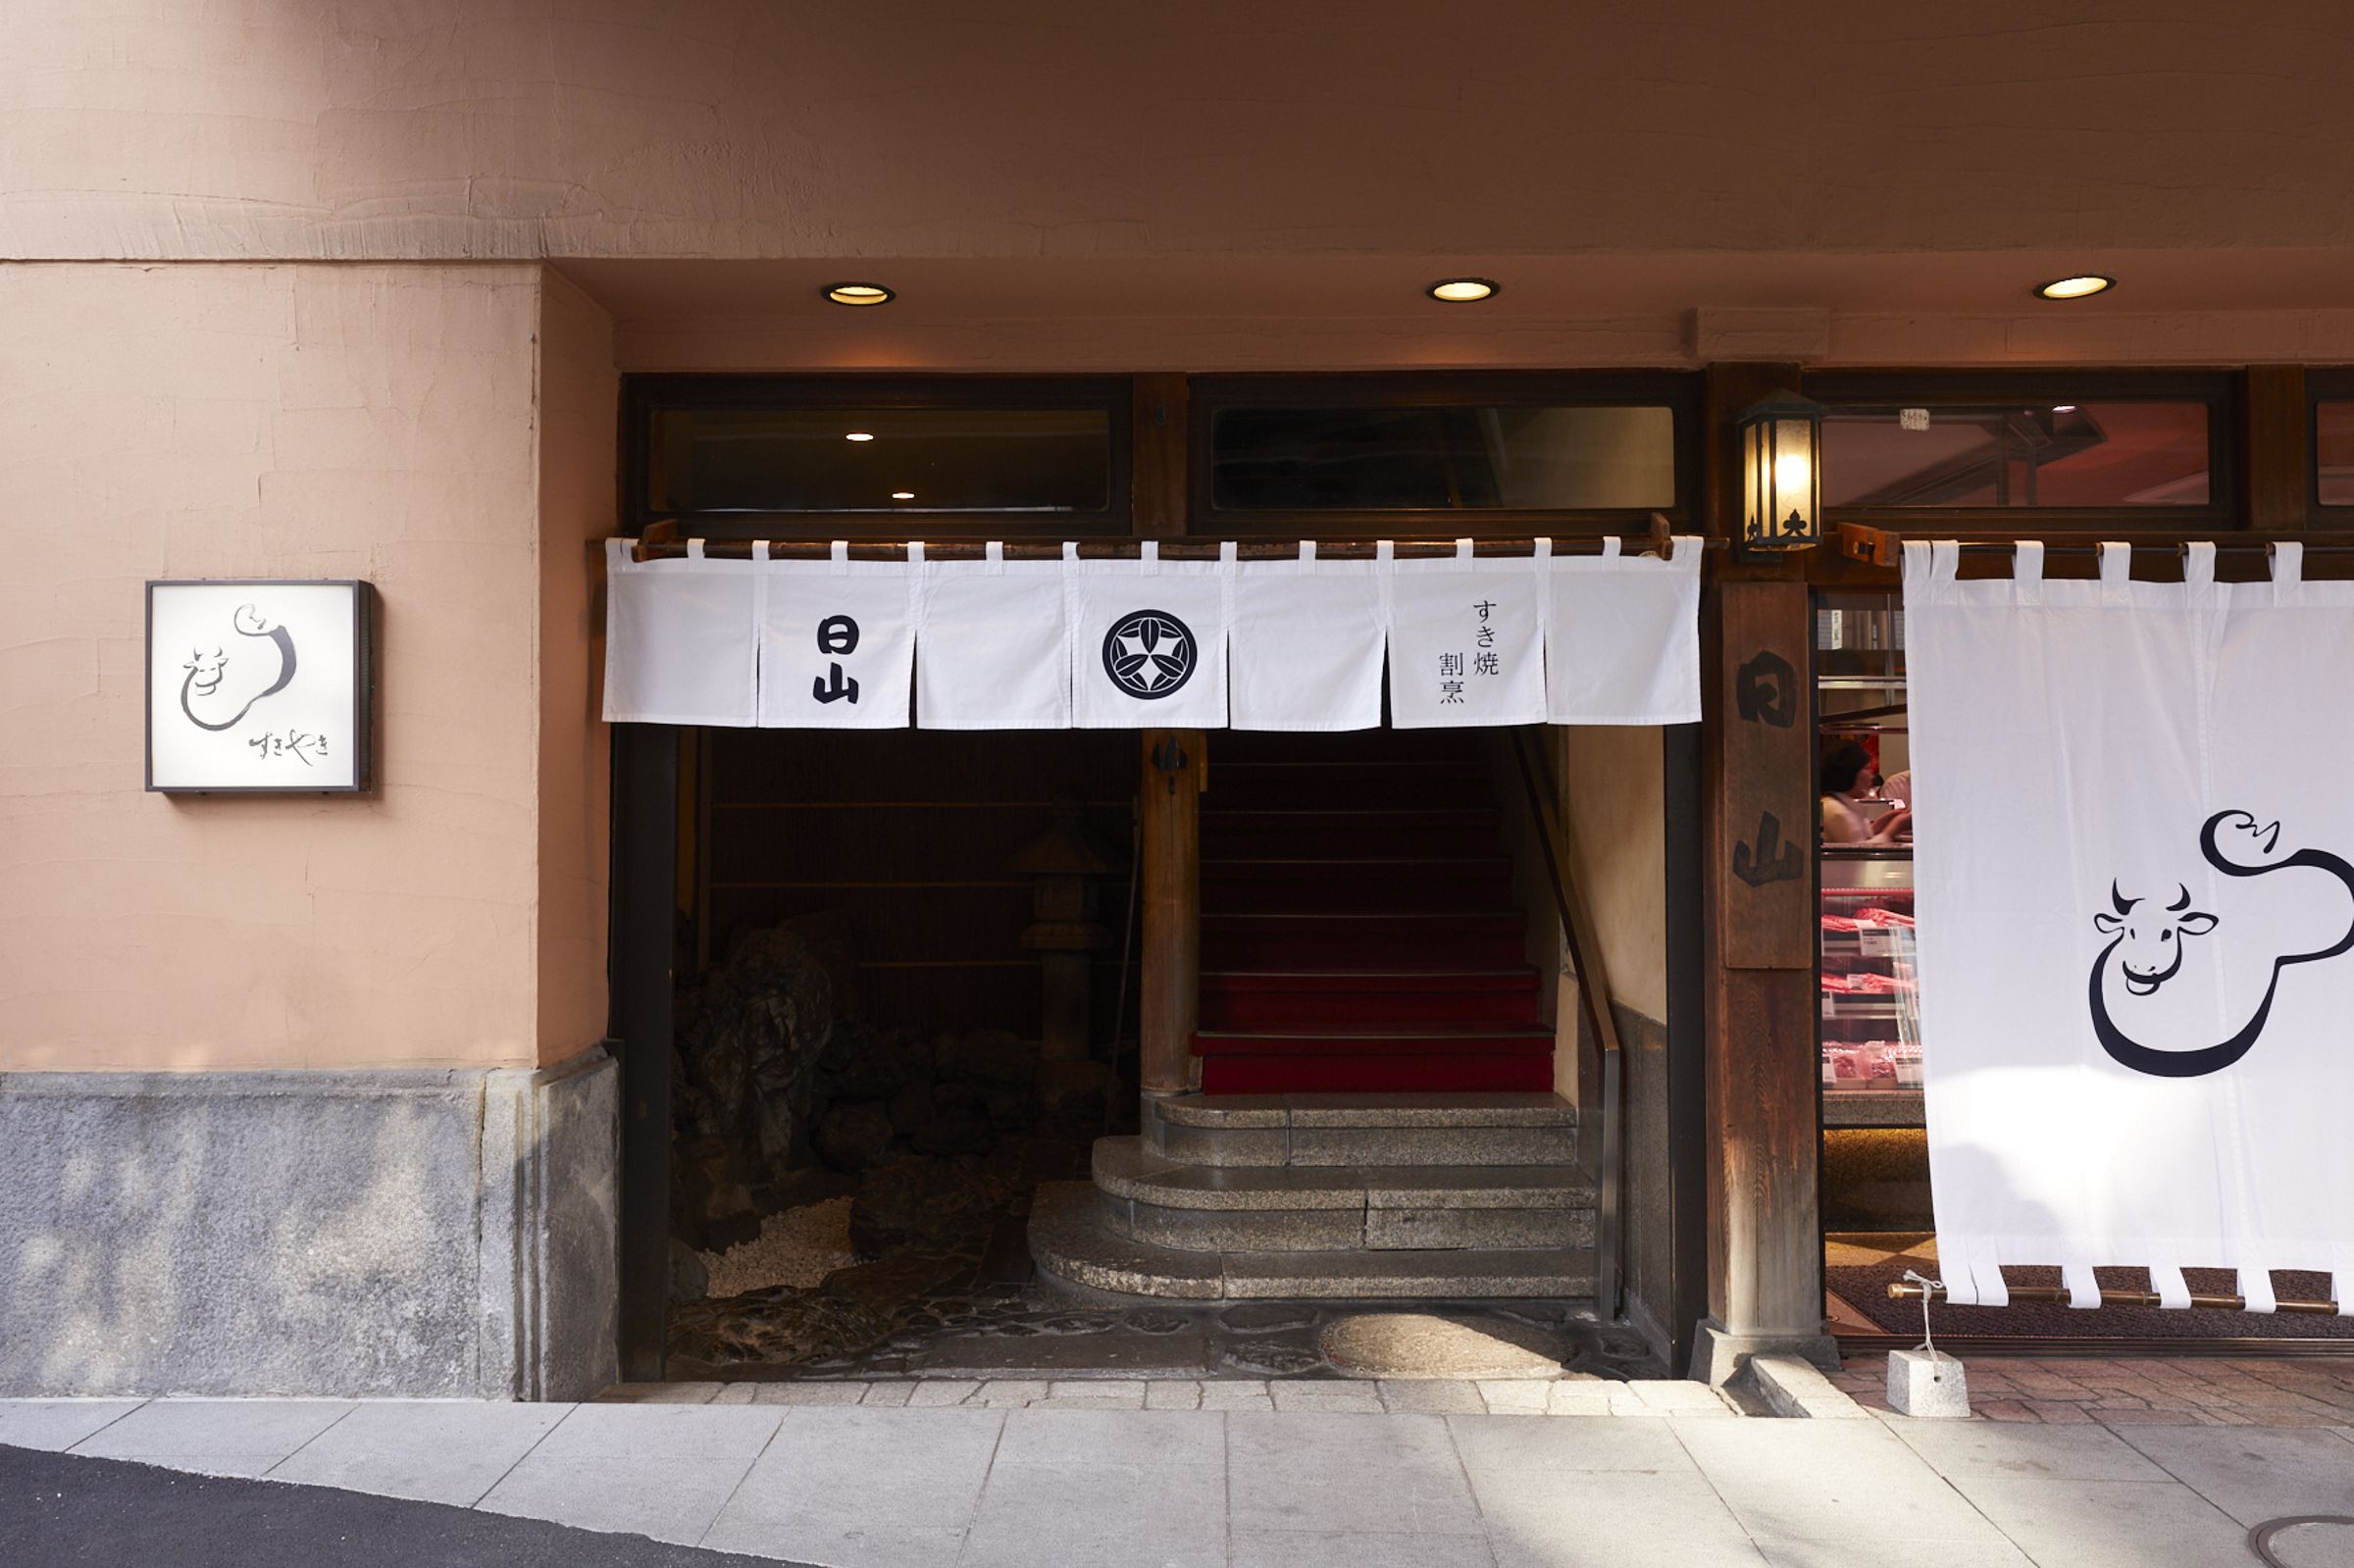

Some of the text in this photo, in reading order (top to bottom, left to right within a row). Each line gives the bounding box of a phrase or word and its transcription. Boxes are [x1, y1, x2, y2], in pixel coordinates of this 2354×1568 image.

[812, 614, 860, 705] 日山
[1472, 599, 1500, 676] すき焼
[1439, 652, 1464, 705] 割烹
[248, 729, 329, 767] すきやき
[1732, 649, 1805, 887] 日山
